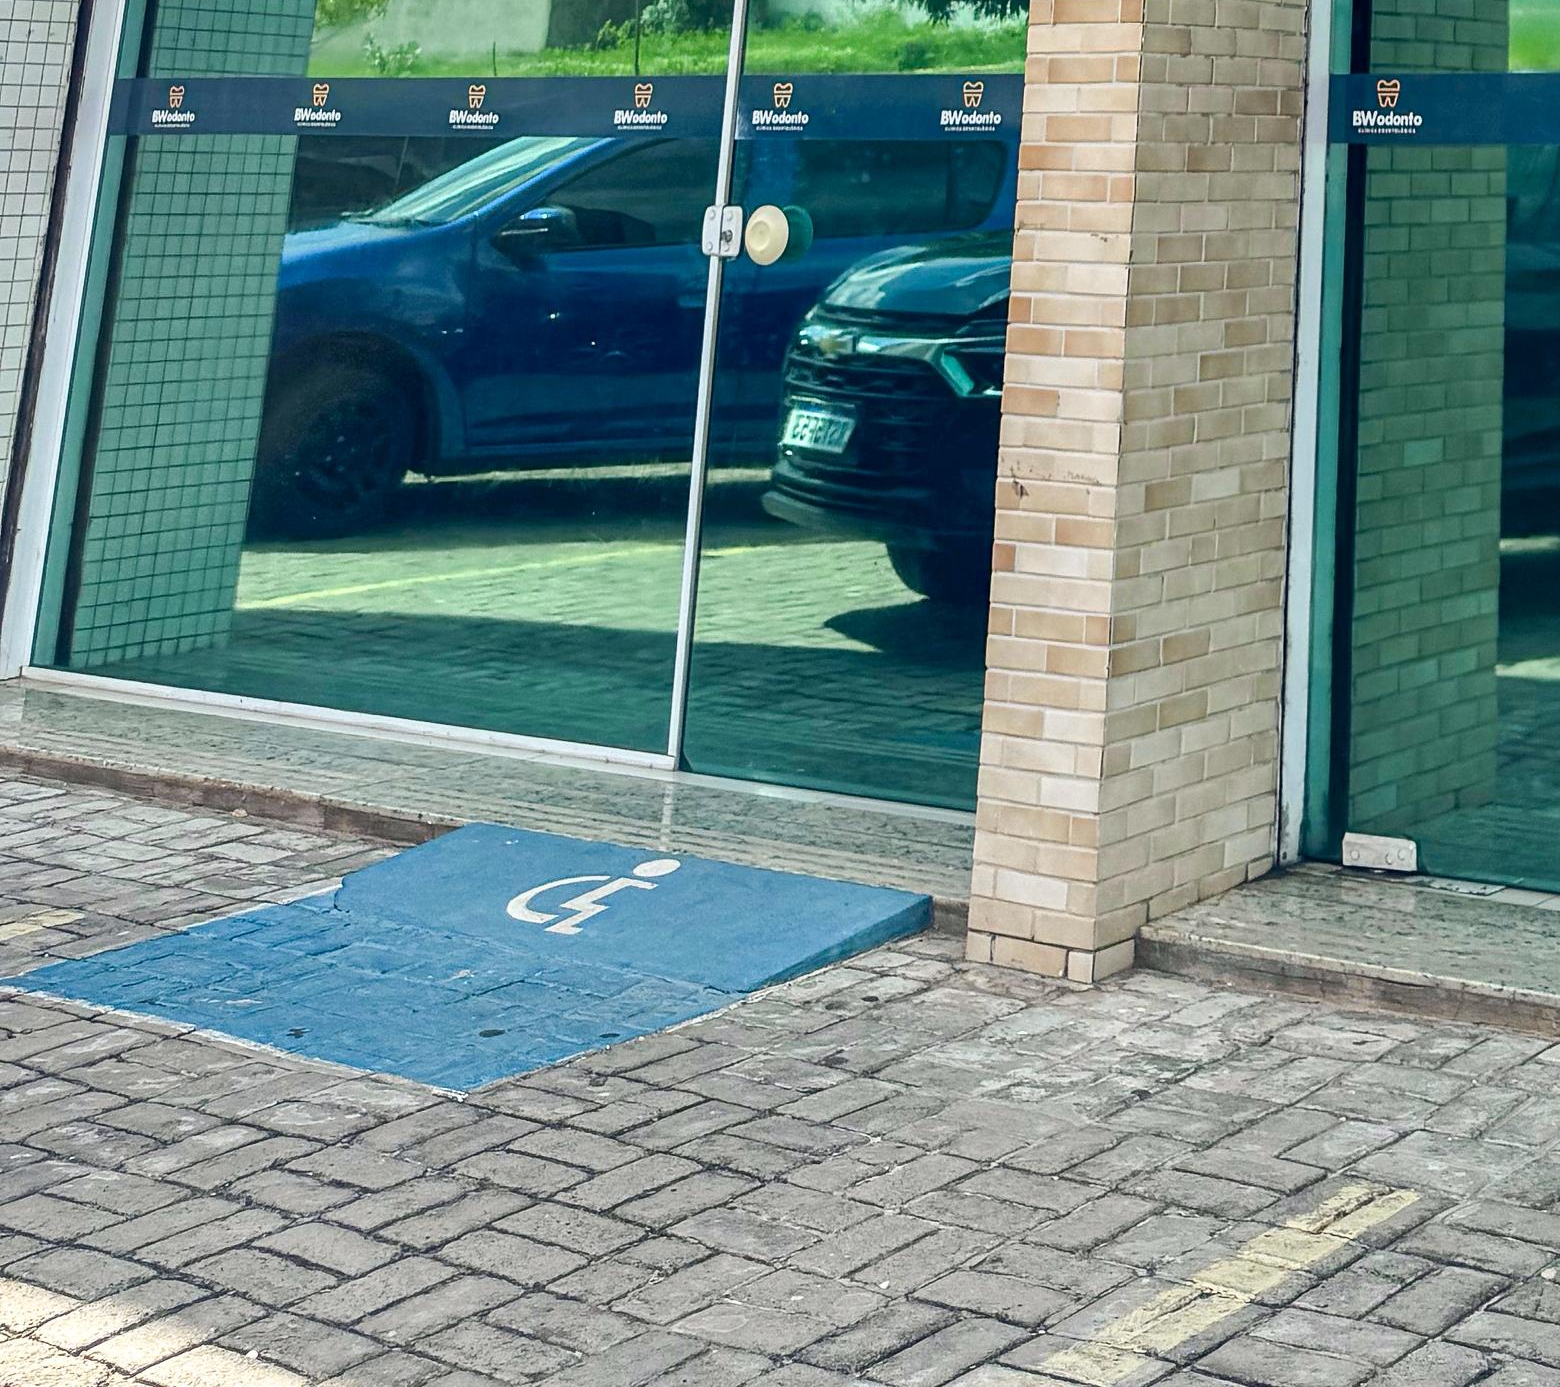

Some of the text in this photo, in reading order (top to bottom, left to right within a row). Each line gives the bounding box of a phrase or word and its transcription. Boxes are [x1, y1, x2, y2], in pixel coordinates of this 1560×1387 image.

[613, 110, 668, 124] BWodonto
[752, 110, 809, 125] BWodonto
[940, 110, 1002, 125] BWodonto
[1352, 110, 1423, 127] BWodonto
